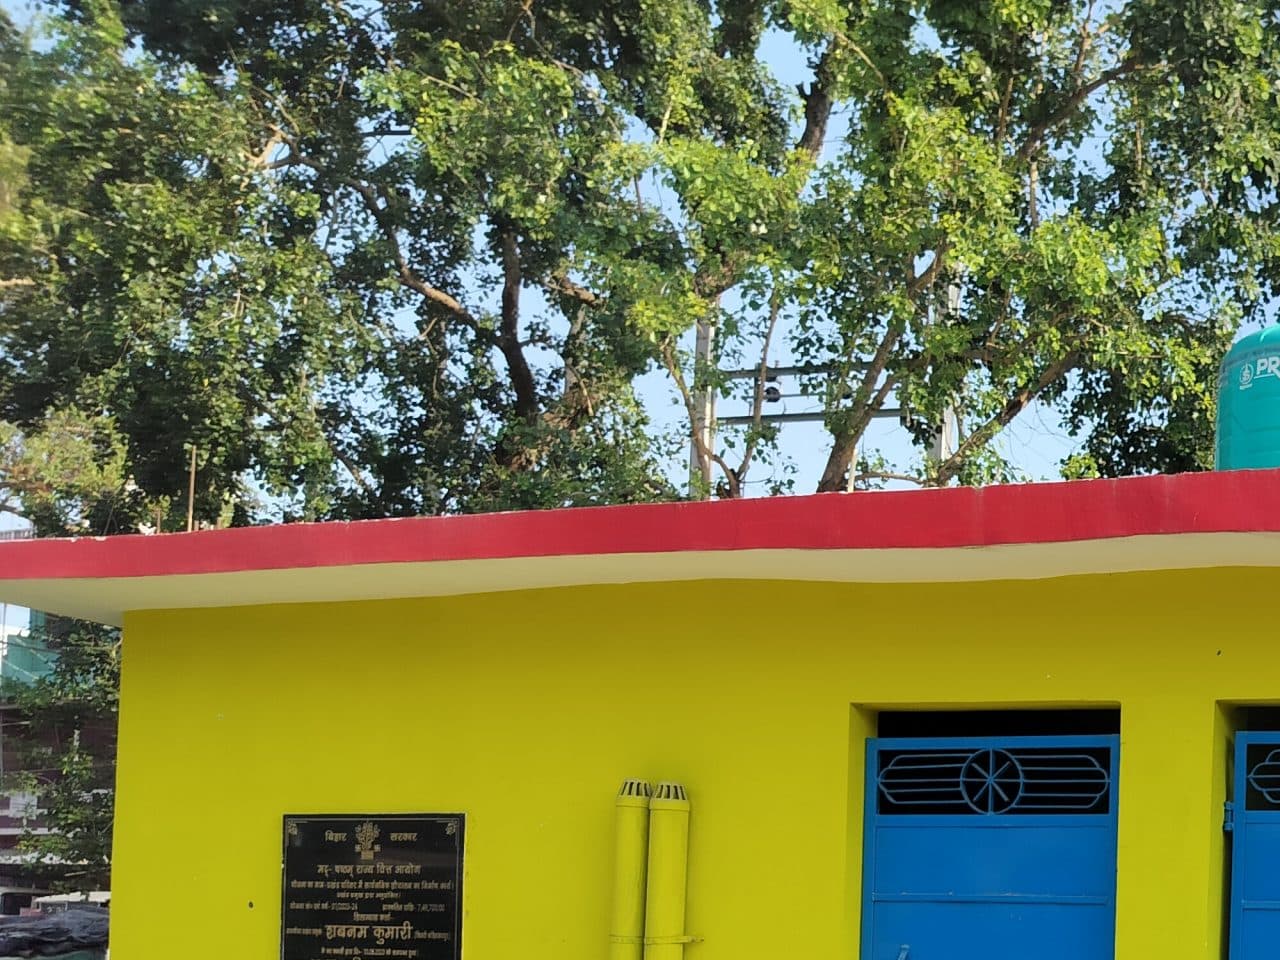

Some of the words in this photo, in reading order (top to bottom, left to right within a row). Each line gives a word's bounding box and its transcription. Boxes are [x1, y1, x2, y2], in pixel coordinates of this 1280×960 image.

[325, 830, 347, 842] बिहार
[390, 832, 418, 842] सरकार
[324, 925, 370, 940] शबनम
[372, 920, 414, 945] कुमारी
